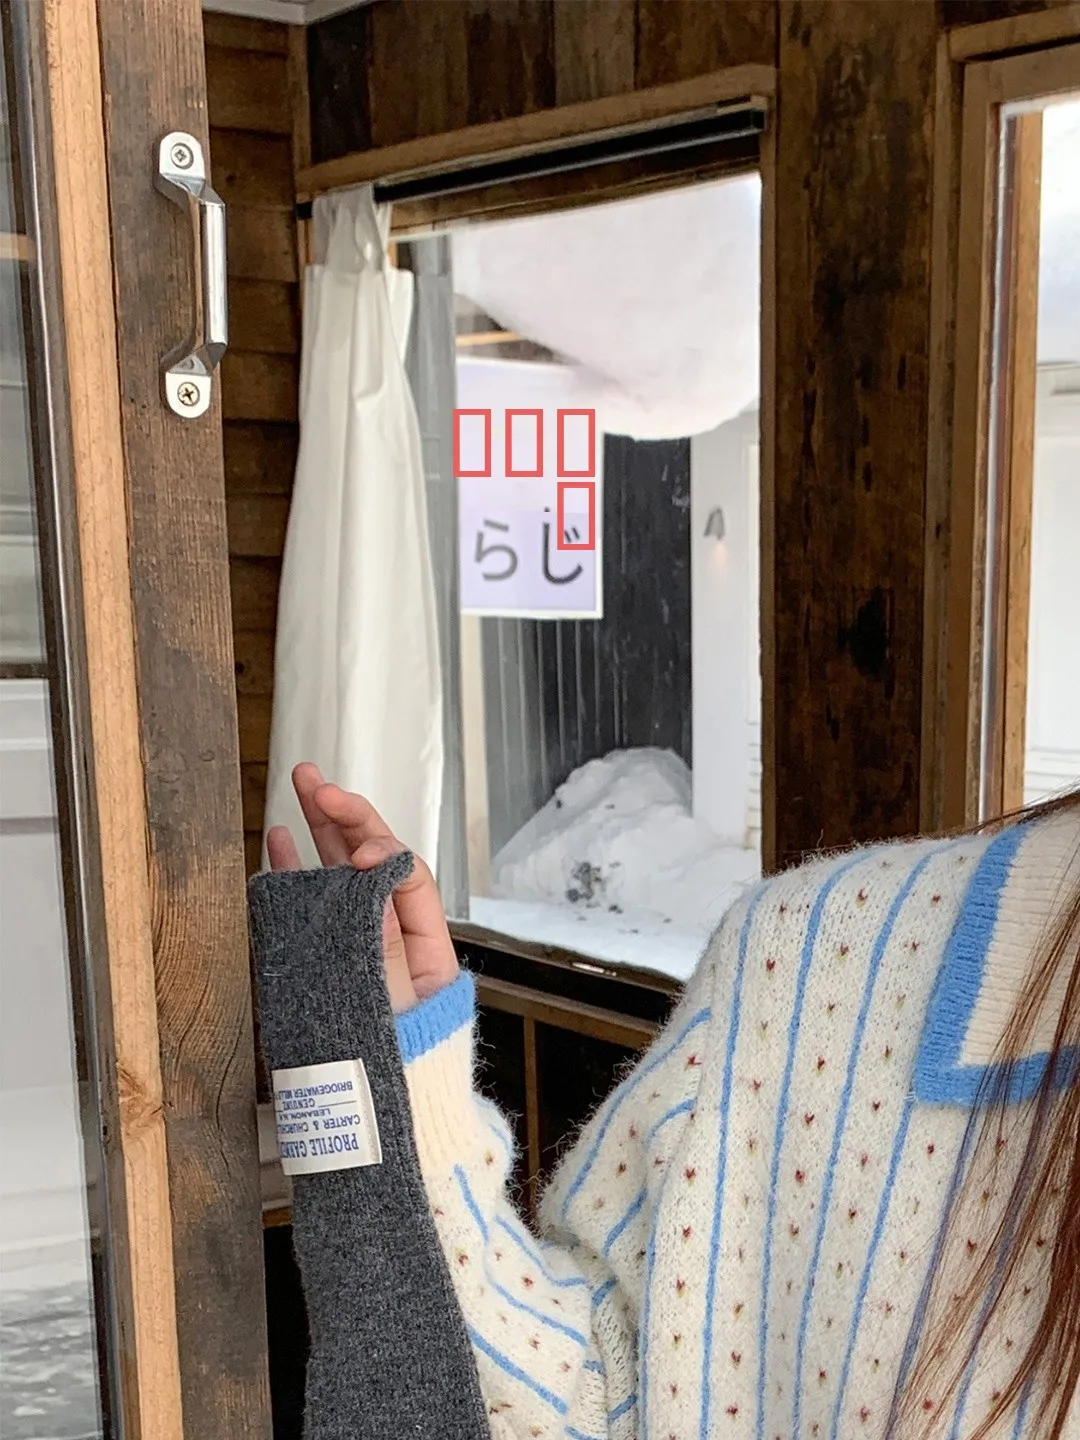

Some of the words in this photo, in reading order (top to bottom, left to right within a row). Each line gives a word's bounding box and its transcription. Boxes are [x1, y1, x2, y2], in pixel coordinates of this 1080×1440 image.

[282, 1098, 316, 1111] GENUINE
[313, 1120, 320, 1131] &
[323, 1114, 361, 1130] CARTER
[309, 1133, 359, 1156] PROFILE
